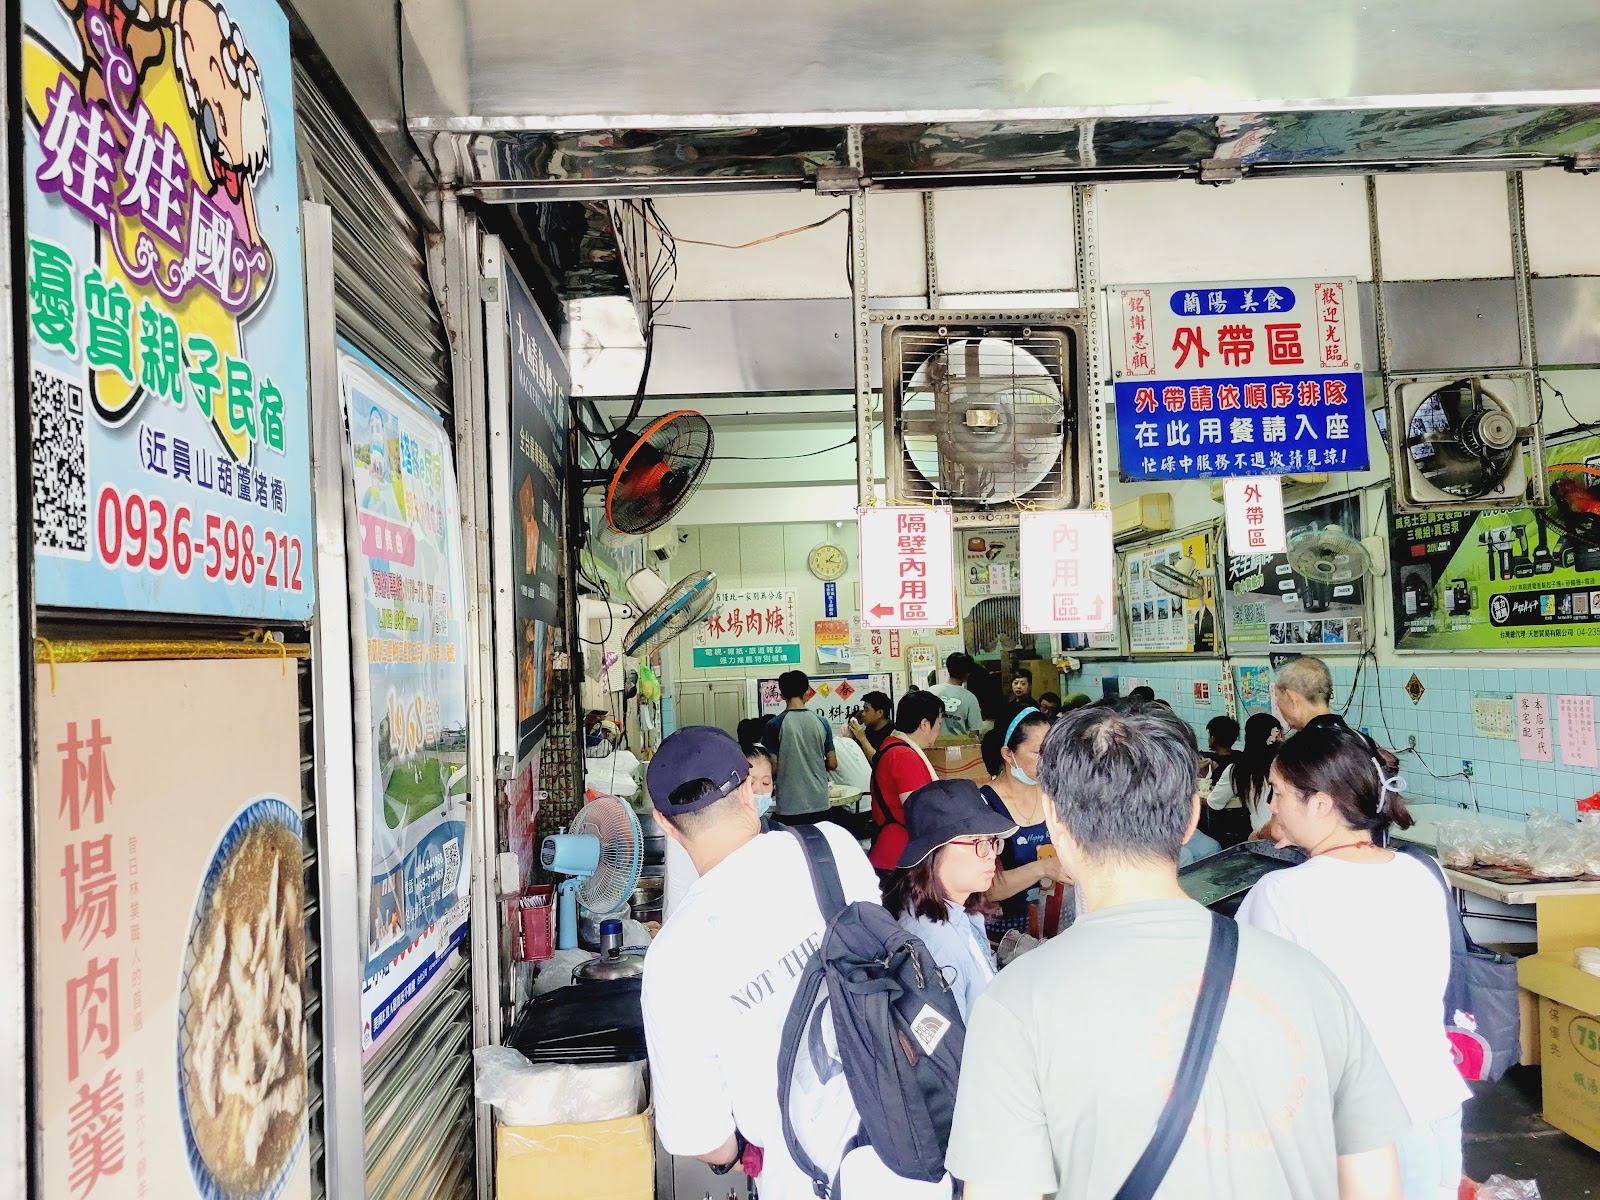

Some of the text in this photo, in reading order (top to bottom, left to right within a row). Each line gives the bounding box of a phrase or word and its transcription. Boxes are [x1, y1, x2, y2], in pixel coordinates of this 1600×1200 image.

[40, 77, 236, 302] 娃娃國
[1128, 296, 1149, 370] 銘謝惠顧
[1183, 291, 1284, 314] 蘭陽美食
[1321, 287, 1342, 362] 歡迎光臨
[1171, 323, 1304, 369] 外帶區
[1135, 380, 1347, 413] 外帶請依順序排隊
[1135, 413, 1350, 449] 在此用餐請入座
[99, 487, 302, 591] 0936-598-212
[1243, 484, 1266, 547] 外帶區
[897, 513, 928, 621] 隔壁內用區
[1053, 523, 1081, 621] 內用區
[840, 686, 852, 697] 春
[1521, 698, 1532, 738] 客宅配
[1534, 698, 1547, 755] 本店可代
[57, 718, 126, 1200] 林場肉羹
[730, 932, 819, 1015] NOT THE
